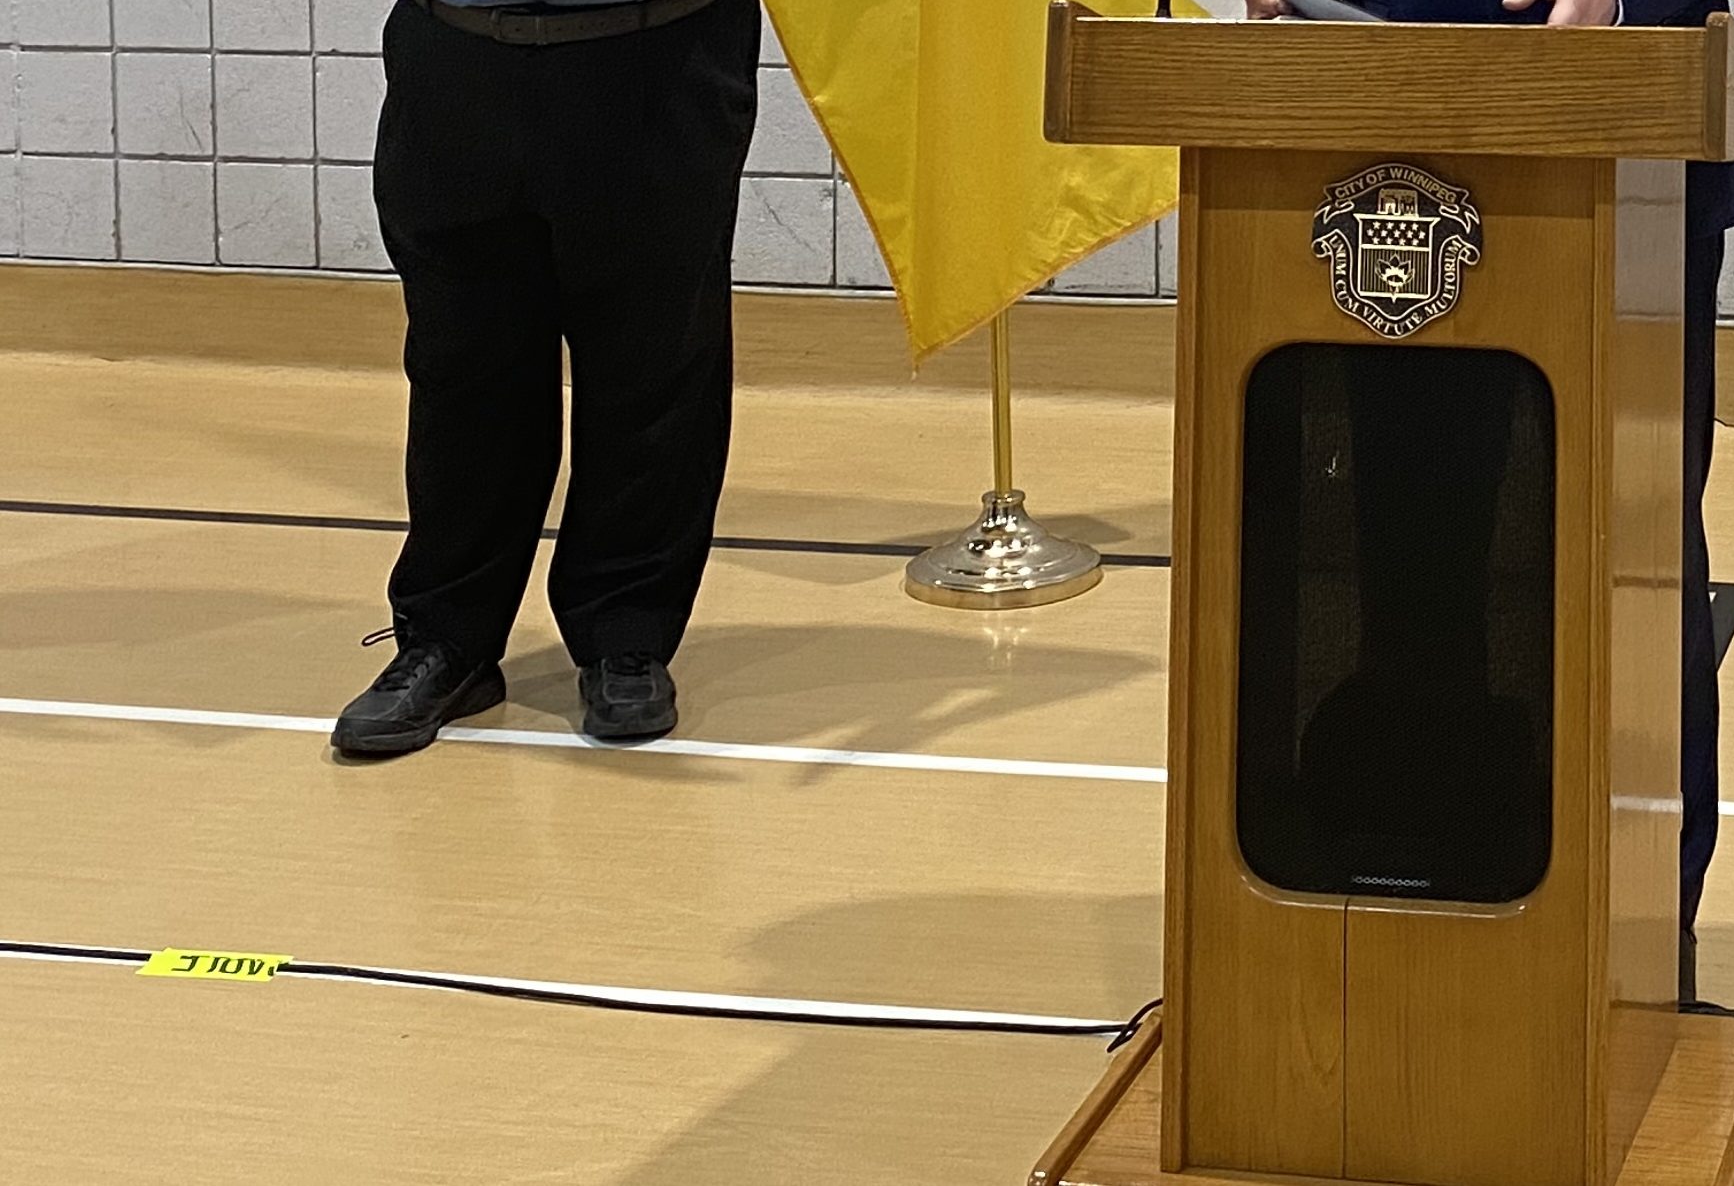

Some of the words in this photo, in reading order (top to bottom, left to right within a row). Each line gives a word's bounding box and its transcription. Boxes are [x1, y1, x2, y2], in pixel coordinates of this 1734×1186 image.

[1334, 176, 1366, 200] CITY
[1365, 169, 1387, 185] OF
[1389, 167, 1458, 204] WINNIPEG
[1328, 235, 1347, 276] UNUM
[1335, 279, 1360, 313] CUM
[1424, 239, 1463, 317] MULTORUM
[1362, 305, 1424, 336] VIRTUTE
